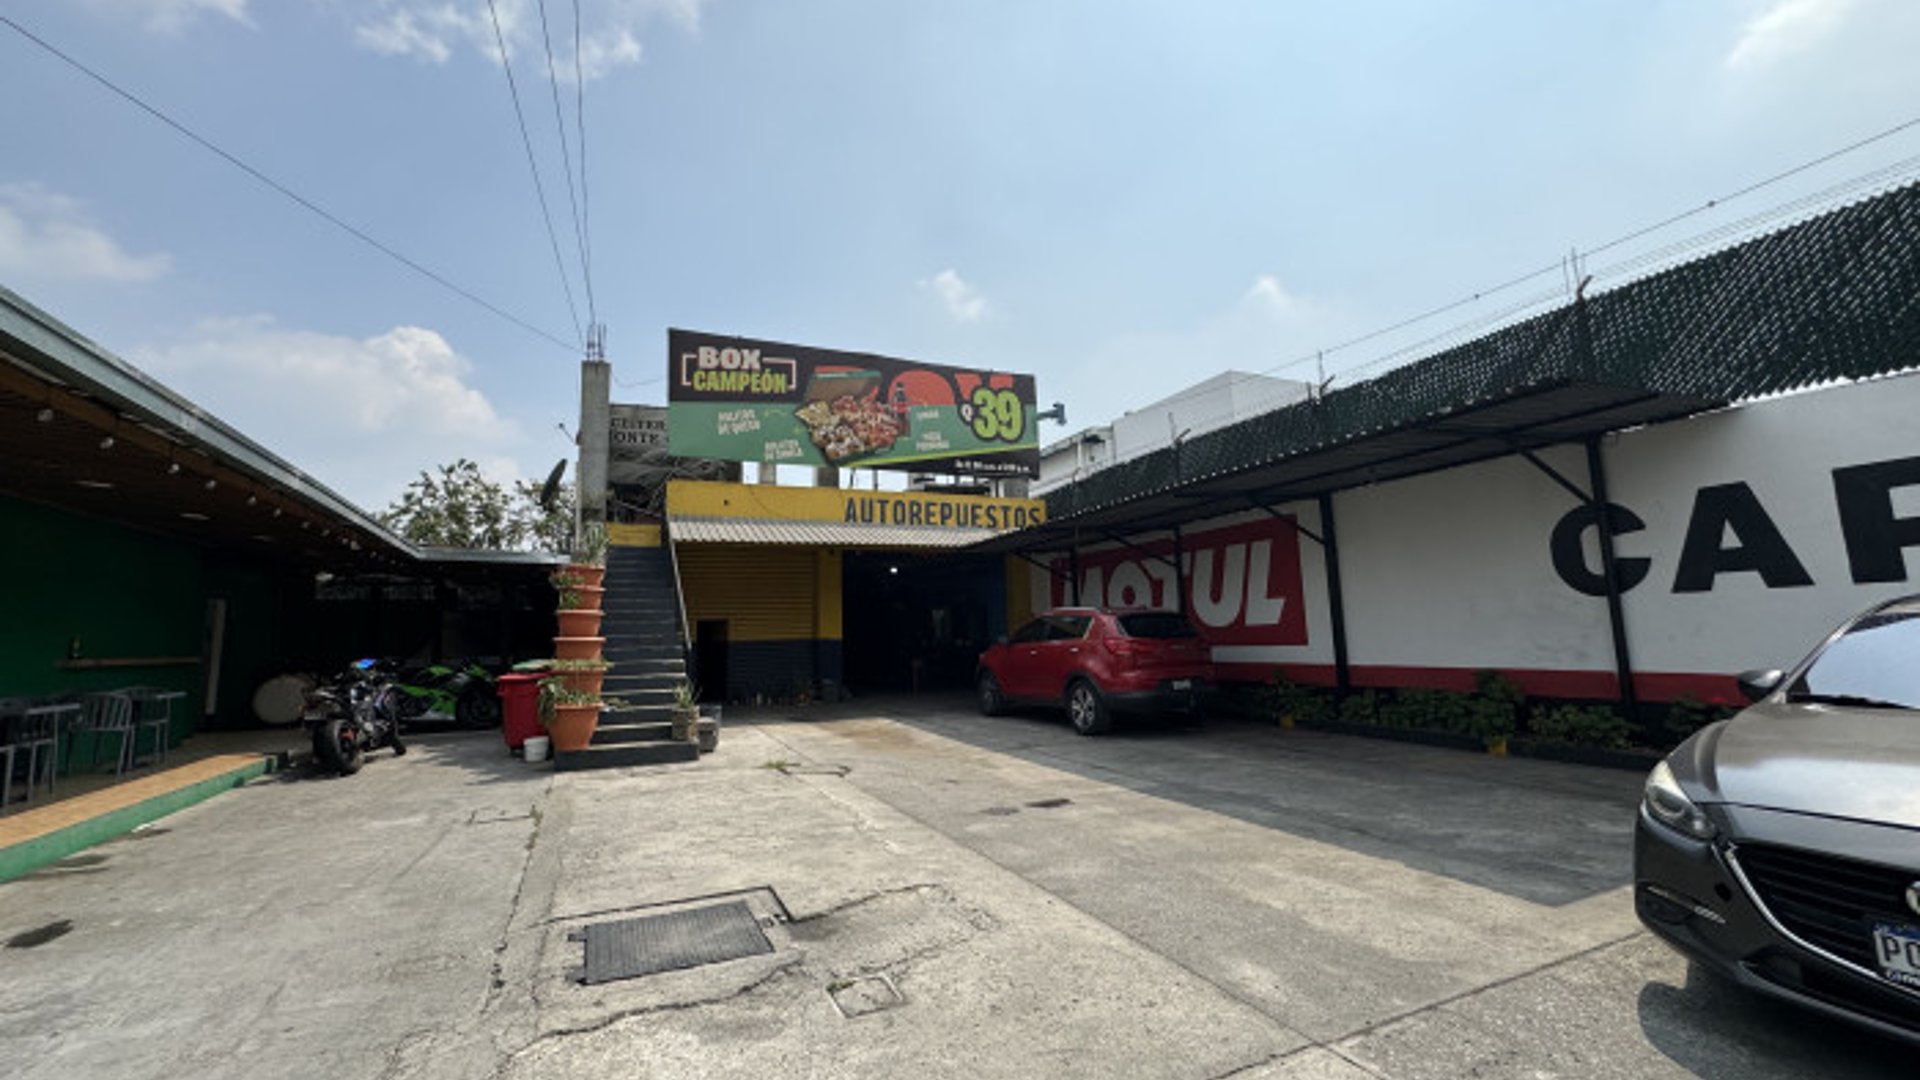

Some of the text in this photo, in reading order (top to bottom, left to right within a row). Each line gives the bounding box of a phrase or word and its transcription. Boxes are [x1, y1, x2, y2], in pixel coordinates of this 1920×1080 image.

[698, 346, 761, 370] BOX
[692, 368, 788, 395] CAMPEÓN
[973, 387, 1023, 440] 39
[844, 497, 1041, 529] AUTOREPUESTOS
